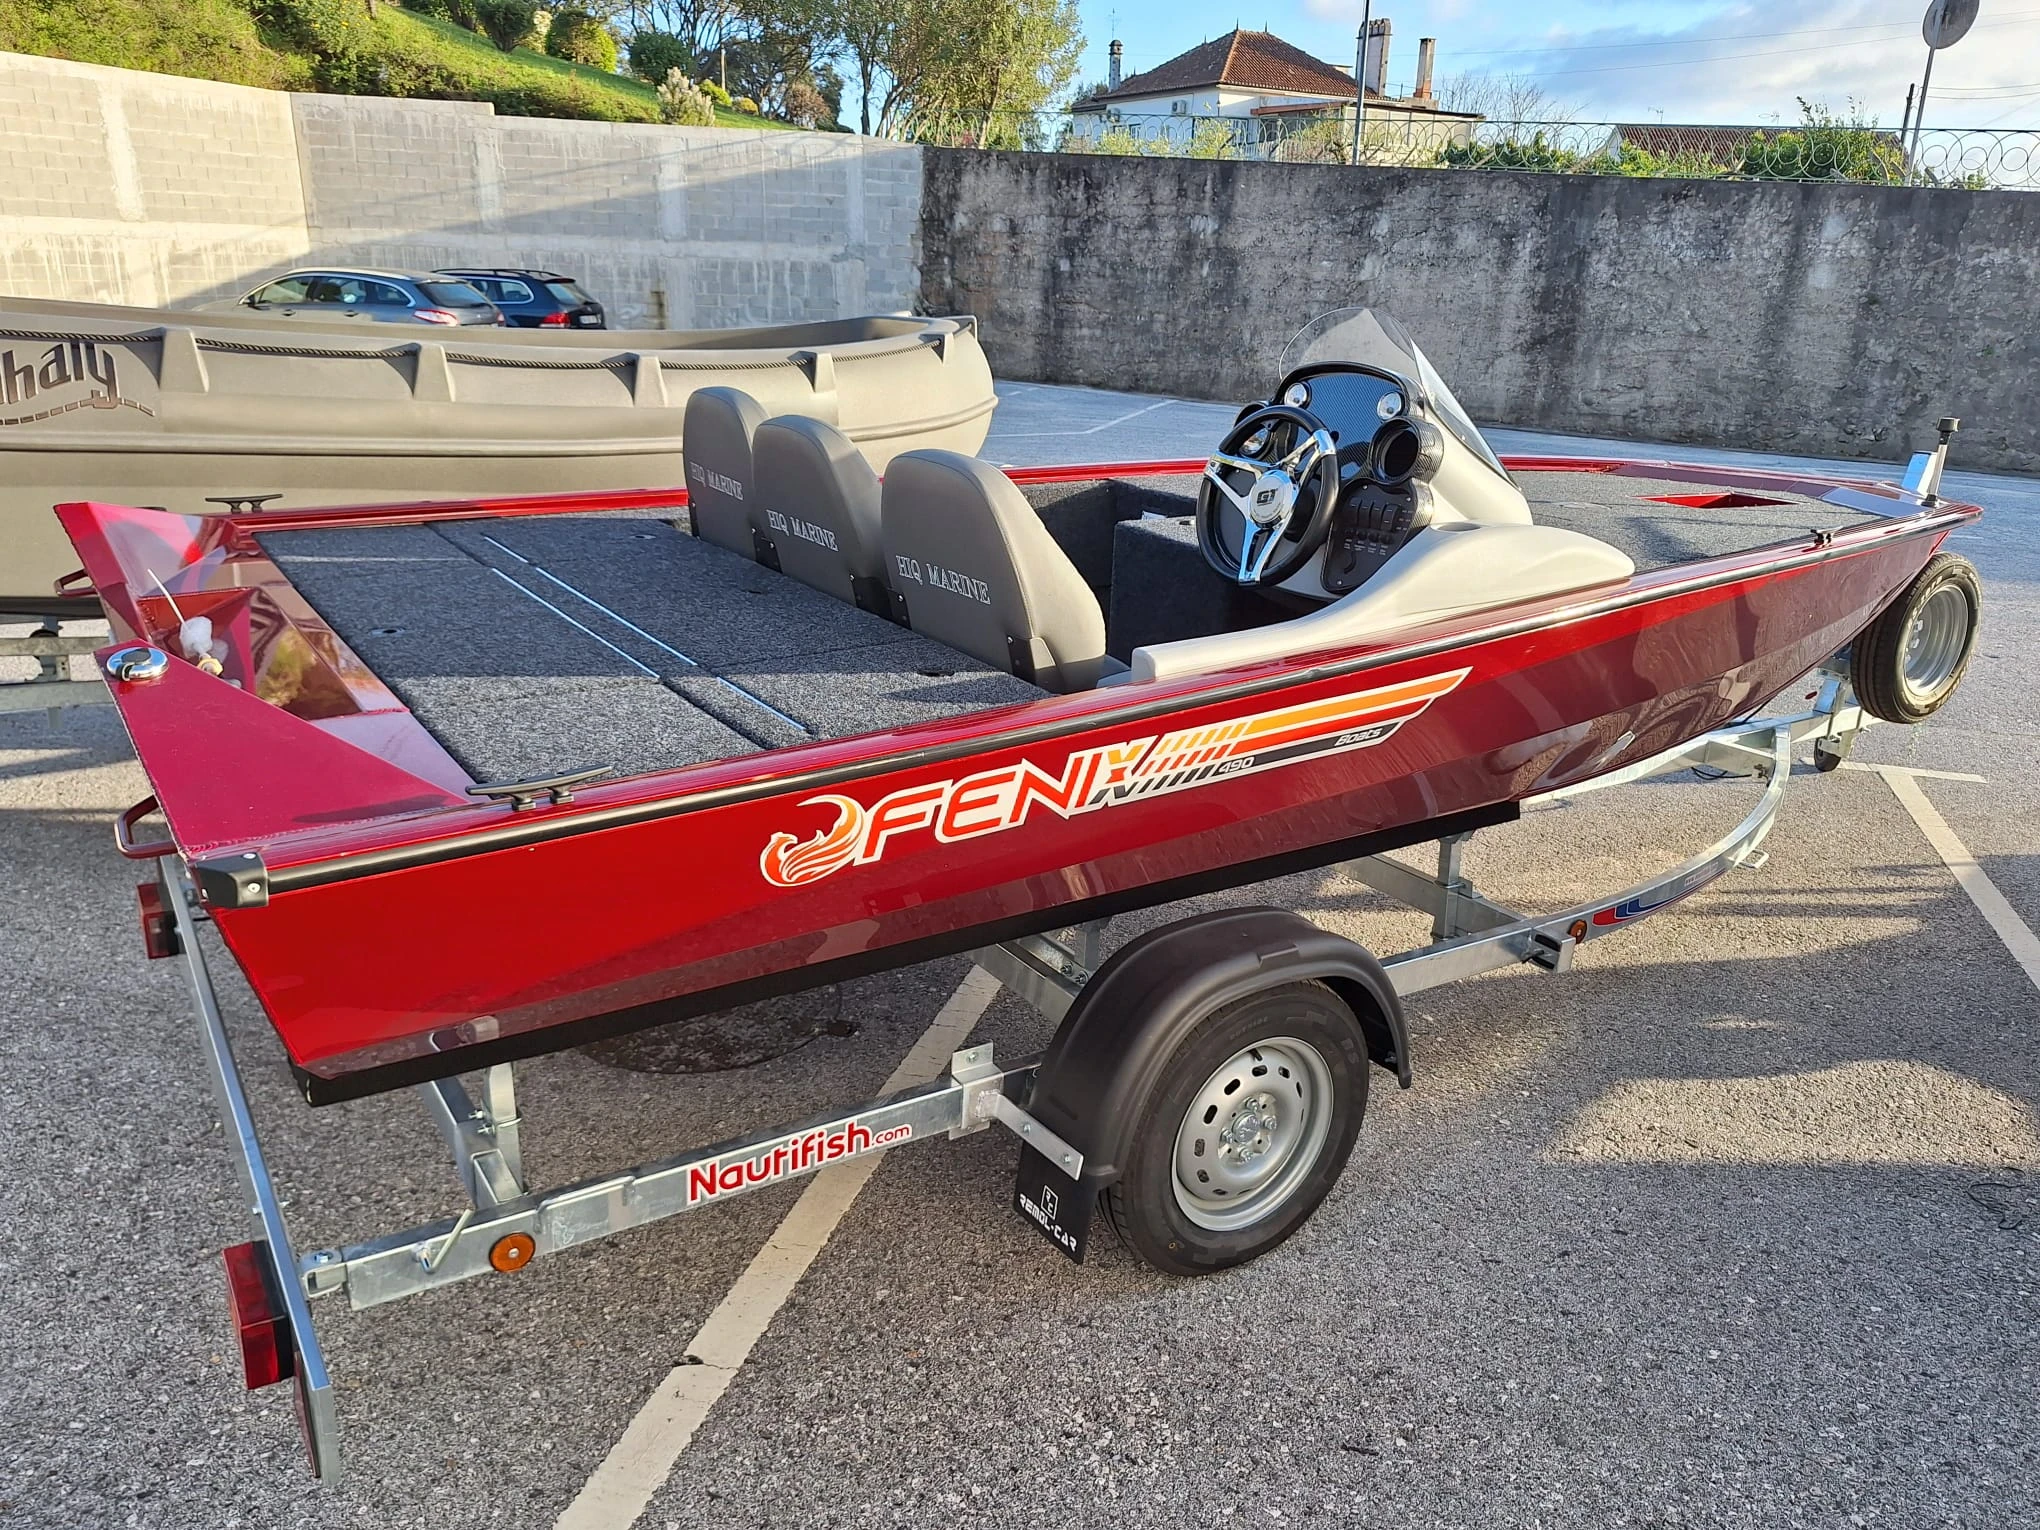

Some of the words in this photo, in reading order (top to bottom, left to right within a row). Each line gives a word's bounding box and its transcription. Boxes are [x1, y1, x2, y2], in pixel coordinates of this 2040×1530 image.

[0, 340, 119, 409] haly
[690, 461, 706, 487] HIQ
[706, 469, 744, 501] MARINE
[765, 509, 789, 536] HIQ
[789, 516, 839, 552] MARINE
[896, 555, 923, 585] HIQ
[926, 563, 991, 605] MARINE
[1217, 756, 1256, 774] 490
[1334, 727, 1384, 747] Boats
[857, 739, 1152, 863] FENIX
